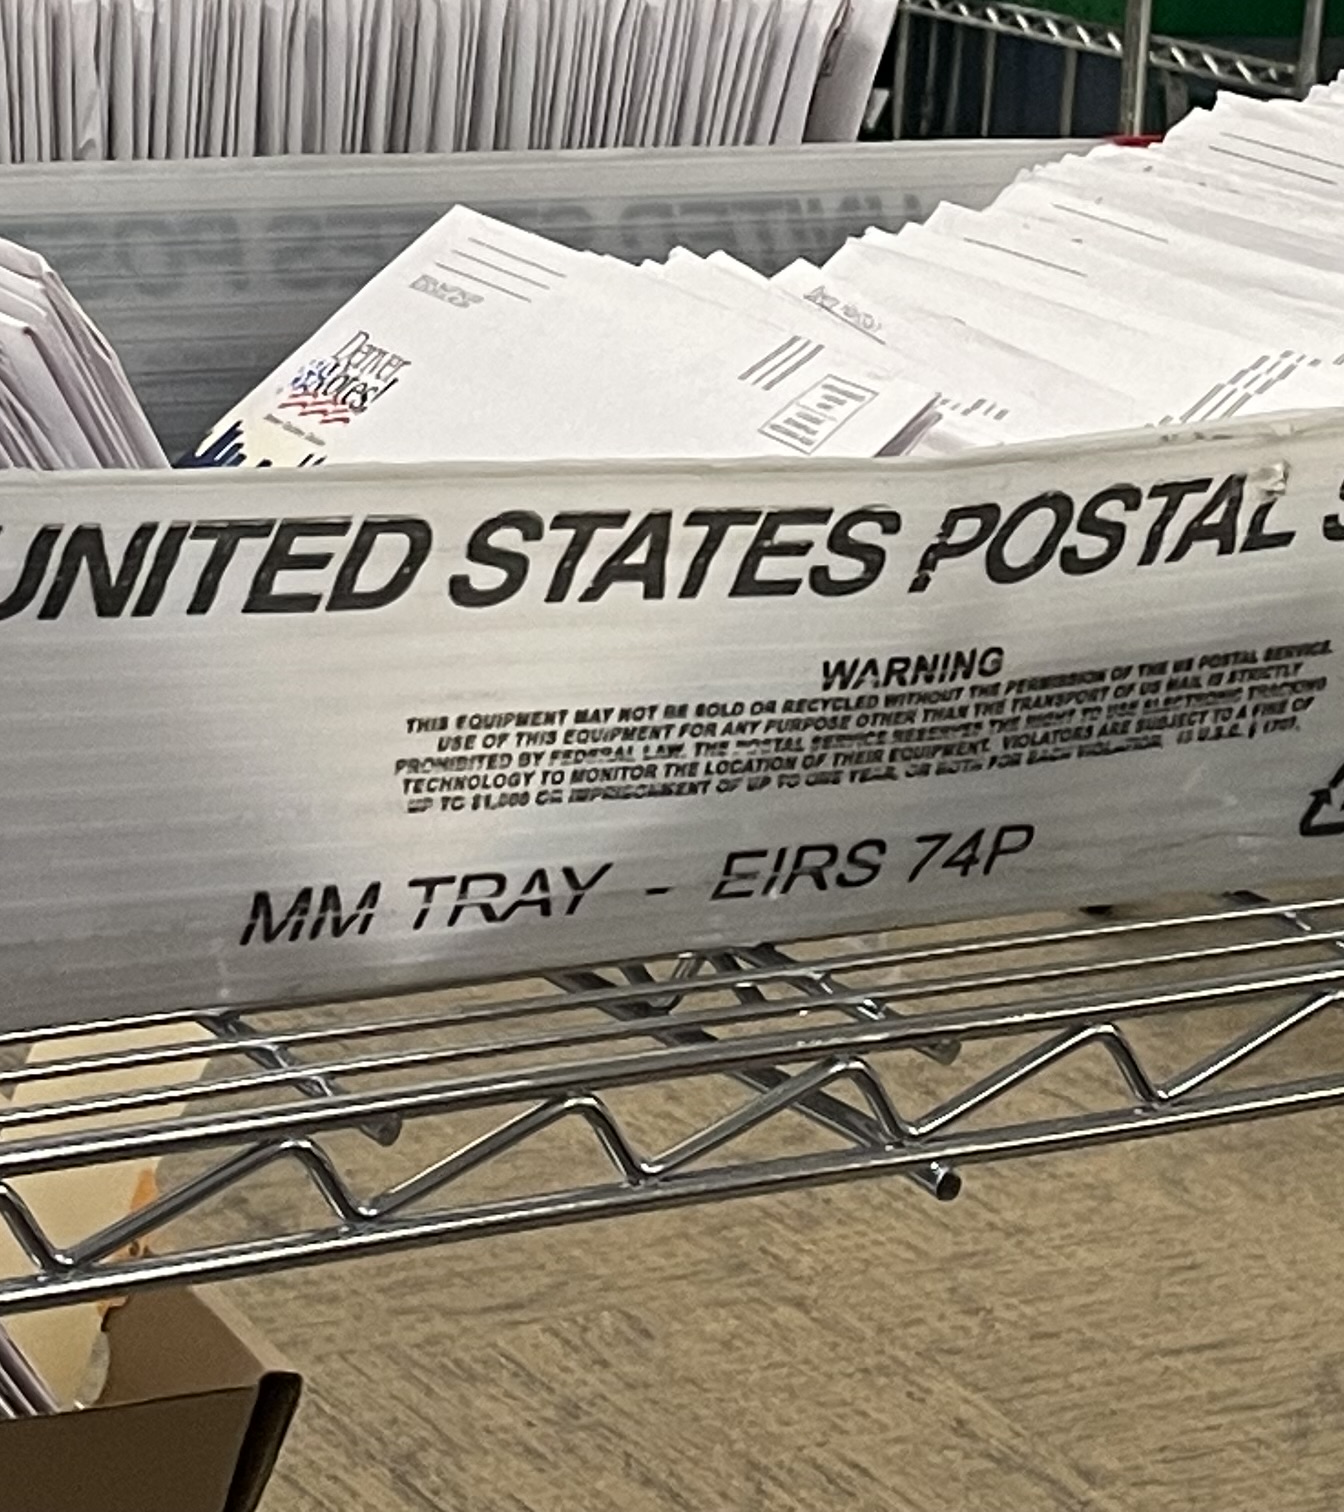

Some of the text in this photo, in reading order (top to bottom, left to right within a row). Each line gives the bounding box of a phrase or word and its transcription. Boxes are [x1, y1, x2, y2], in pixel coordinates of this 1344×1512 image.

[448, 503, 903, 608] STATES
[906, 471, 1297, 594] POSTAL
[406, 714, 449, 734] THIS
[456, 709, 569, 731] EQUIPMENT
[573, 707, 615, 724] MAY
[618, 704, 659, 722] NOT
[663, 703, 689, 719] BE
[695, 701, 744, 718] SOLD
[750, 699, 777, 715] OR
[781, 694, 879, 715] RECYCLED
[884, 686, 965, 708] WITHOUT
[970, 682, 1002, 698] THE
[1110, 665, 1134, 681] OF
[1198, 650, 1259, 670] POSTAL
[820, 645, 1005, 692] WARNING
[403, 770, 537, 795] TECHNOLOGY
[541, 768, 565, 786] TO
[570, 763, 658, 784] MONITOR
[663, 760, 700, 778] THE
[705, 754, 798, 776] LOCATION
[802, 752, 828, 769] OF
[832, 748, 885, 767] THEIR
[1002, 725, 1095, 750] VIOLATORS
[1097, 719, 1133, 738] ARE
[1134, 709, 1210, 734] SUBJECT
[1212, 706, 1234, 723] TO
[1235, 705, 1247, 720] A
[1291, 696, 1315, 712] OF
[437, 733, 477, 753] USE
[481, 732, 511, 749] OF
[515, 729, 558, 749] THIS
[562, 723, 676, 745] EQUIPMENT
[677, 721, 718, 738] FOR
[720, 719, 762, 737] ANY
[763, 714, 852, 734] PURPOSE
[856, 709, 917, 729] OTHER
[922, 704, 970, 723] THAN
[974, 699, 1006, 716] THE
[1011, 686, 1110, 713] TRANSPORT
[1112, 682, 1137, 700] OF
[394, 752, 513, 775] PROHIBITED
[518, 751, 546, 769] BY
[548, 746, 636, 767] FEDERAL
[440, 795, 466, 812] TO
[715, 776, 743, 794] OF
[239, 881, 382, 946] MM
[411, 862, 615, 931] TRAY
[710, 837, 889, 902] EIRS
[907, 823, 1037, 882] 74P
